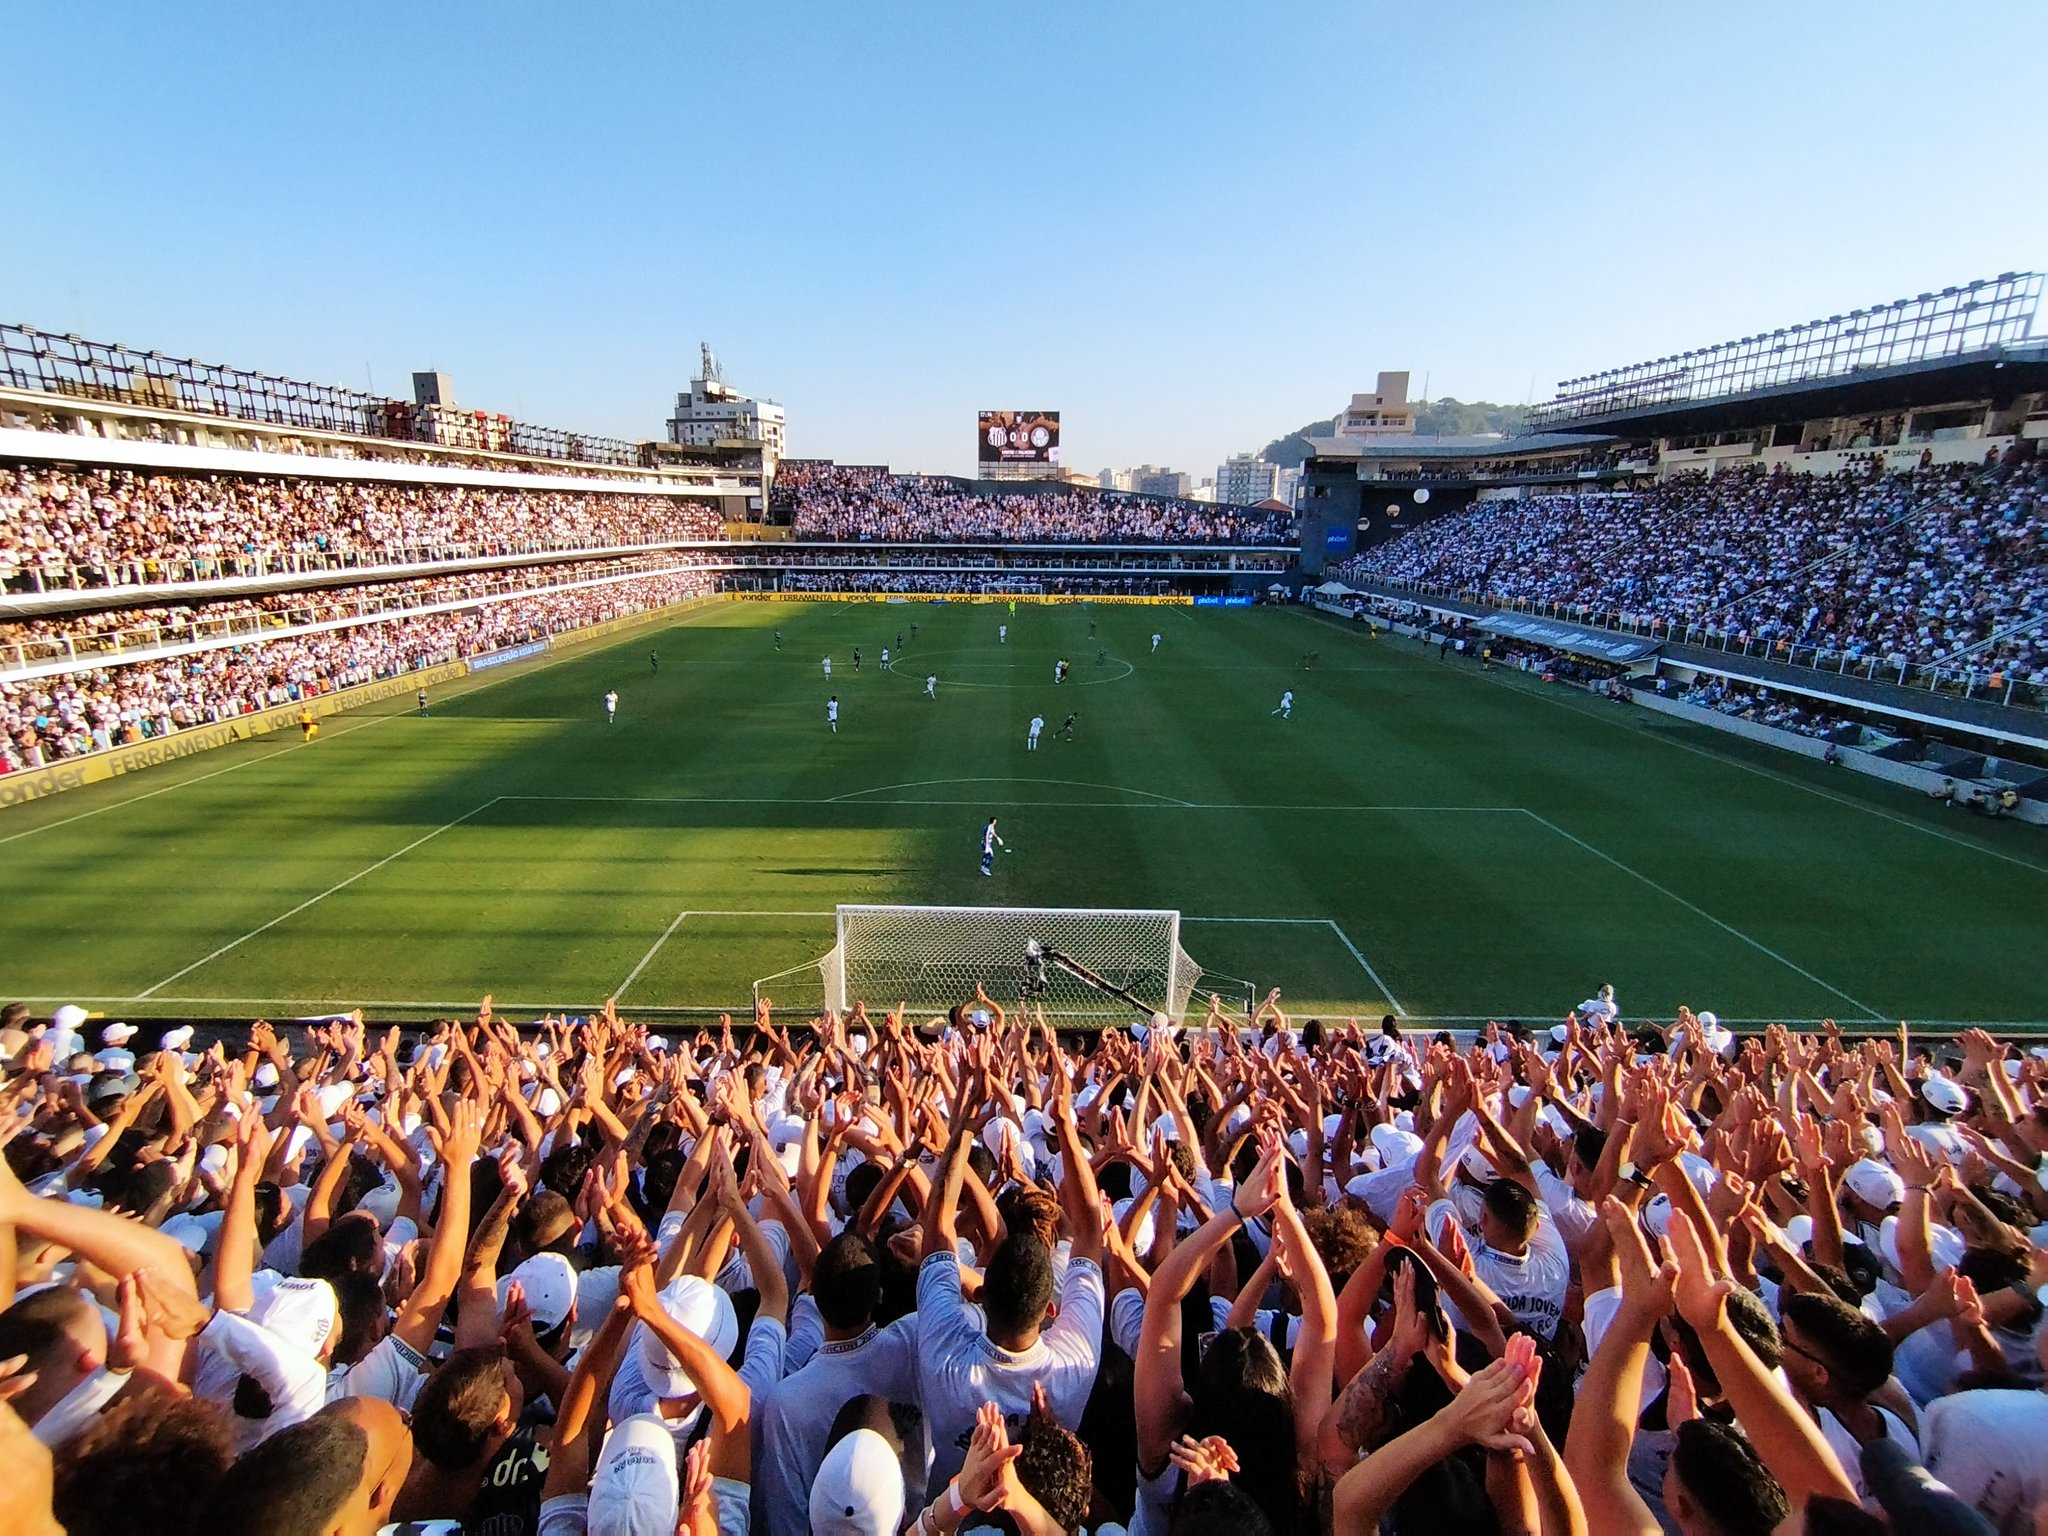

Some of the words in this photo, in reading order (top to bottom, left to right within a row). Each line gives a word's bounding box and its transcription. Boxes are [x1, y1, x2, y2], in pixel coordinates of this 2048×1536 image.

[1010, 432, 1016, 442] 0
[1022, 432, 1028, 442] 0
[740, 593, 771, 601] vonder
[846, 593, 877, 601] vonder
[950, 594, 981, 602] vonder
[988, 595, 1040, 603] FERRAMENTA
[1092, 597, 1144, 605] FERRAMENTA
[1157, 597, 1188, 605] vonder
[108, 725, 241, 776] FERRAMENTA
[248, 715, 259, 737] É
[333, 680, 409, 711] FERRAMENTA
[424, 664, 461, 686] vonder
[493, 1448, 529, 1487] dr.
